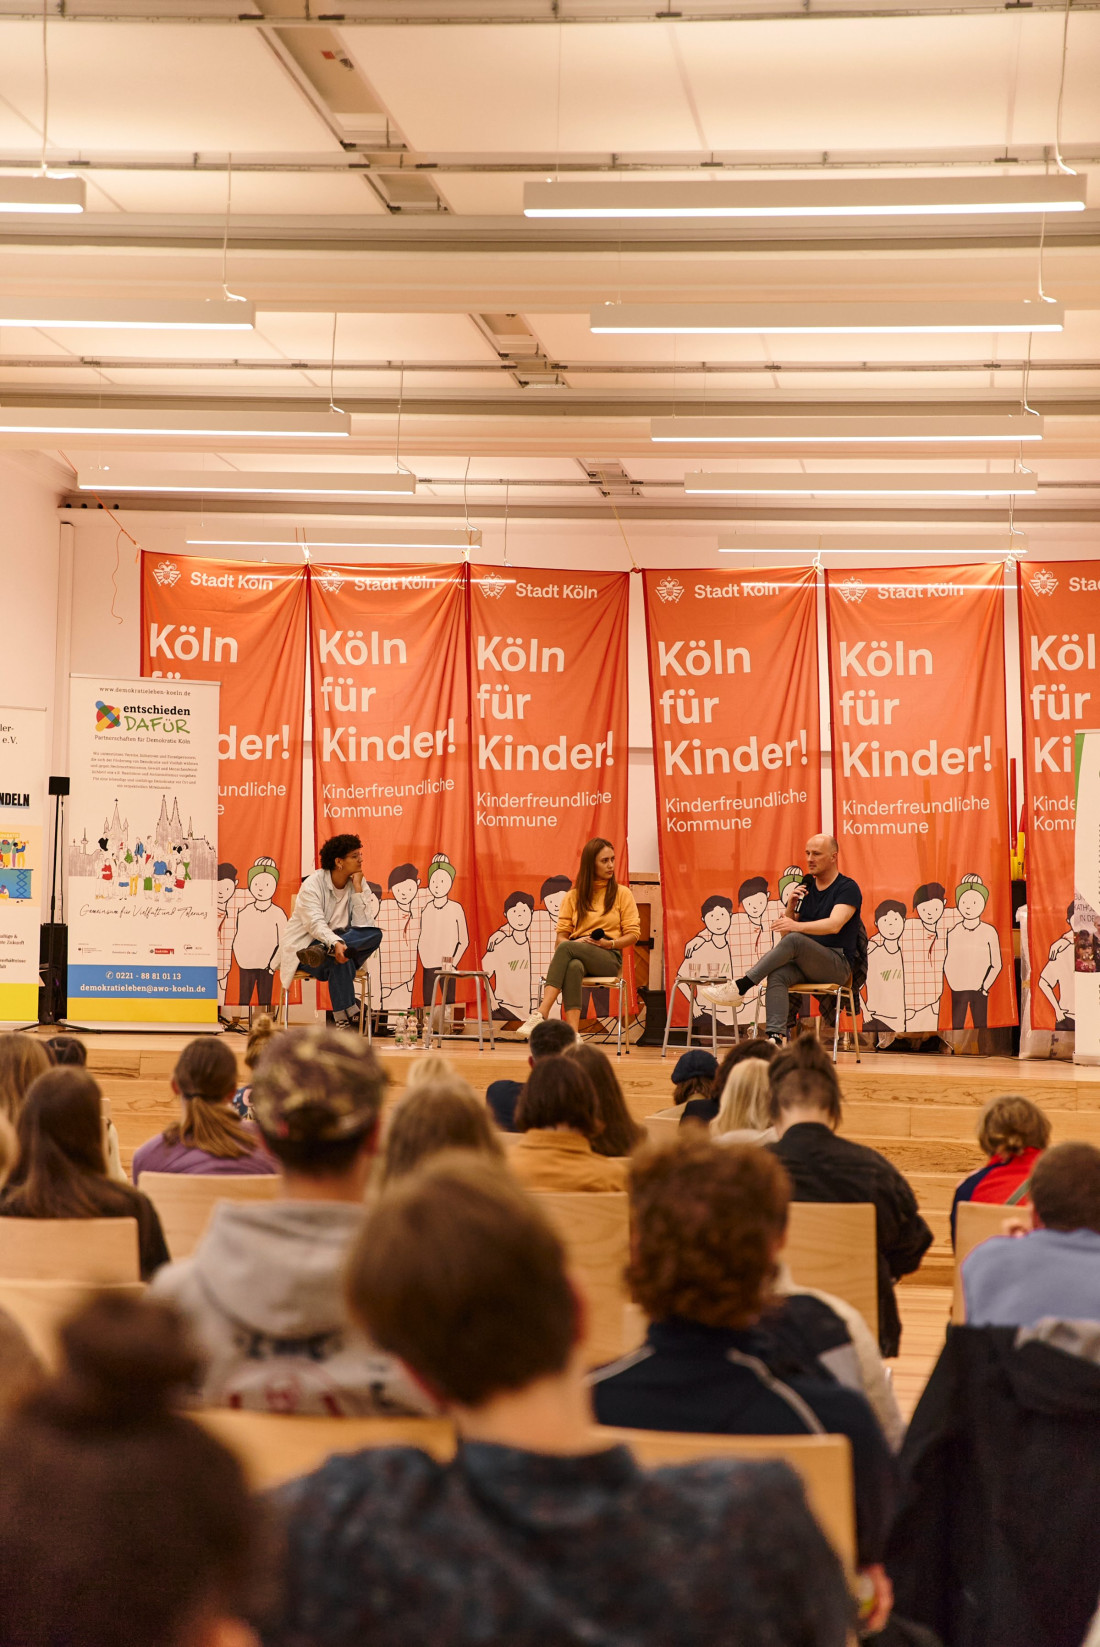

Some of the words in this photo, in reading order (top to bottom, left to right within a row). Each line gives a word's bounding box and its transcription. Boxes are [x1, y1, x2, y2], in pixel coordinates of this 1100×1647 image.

[190, 571, 234, 588] Stadt
[238, 575, 273, 590] Köln
[354, 577, 398, 591] Stadt
[401, 576, 436, 590] Köln
[515, 583, 559, 598] Stadt
[563, 585, 598, 599] Köln
[694, 583, 739, 599] Stadt
[743, 583, 779, 597] Köln
[1069, 577, 1100, 592] Sta
[877, 584, 923, 600] Stadt
[927, 583, 964, 597] Köln
[150, 623, 238, 662] Köln
[319, 629, 407, 666] Köln
[1030, 633, 1096, 671] Köl
[477, 636, 565, 672] Köln
[658, 640, 751, 676] Köln
[839, 641, 933, 677] Köln
[321, 677, 377, 712] für
[476, 684, 531, 720] für
[1030, 684, 1091, 720] für
[123, 705, 191, 716] entschieden
[659, 689, 720, 724] für
[839, 690, 900, 726] für
[124, 715, 190, 734] DAFÜR
[218, 725, 290, 760] der!
[322, 718, 456, 762] Kinder!
[478, 731, 614, 771] Kinder!
[664, 729, 808, 776] Kinder!
[842, 736, 992, 778] Kinder!
[322, 778, 455, 799] Kinderfreundliche
[0, 792, 30, 807] NDELN
[477, 791, 612, 808] Kinderfreundliche
[666, 789, 807, 813] Kinderfreundliche
[842, 795, 990, 816] Kinderfreundliche
[323, 803, 403, 818] Kommune
[476, 811, 558, 827] Kommune
[666, 817, 752, 832] Kommune
[843, 820, 929, 835] Kommune
[115, 972, 134, 980] 0221
[140, 972, 150, 980] 88
[151, 972, 160, 980] 81
[162, 972, 171, 980] 01
[172, 972, 182, 980] 13
[80, 984, 206, 993] demokratieleben@awo-koeln.de
